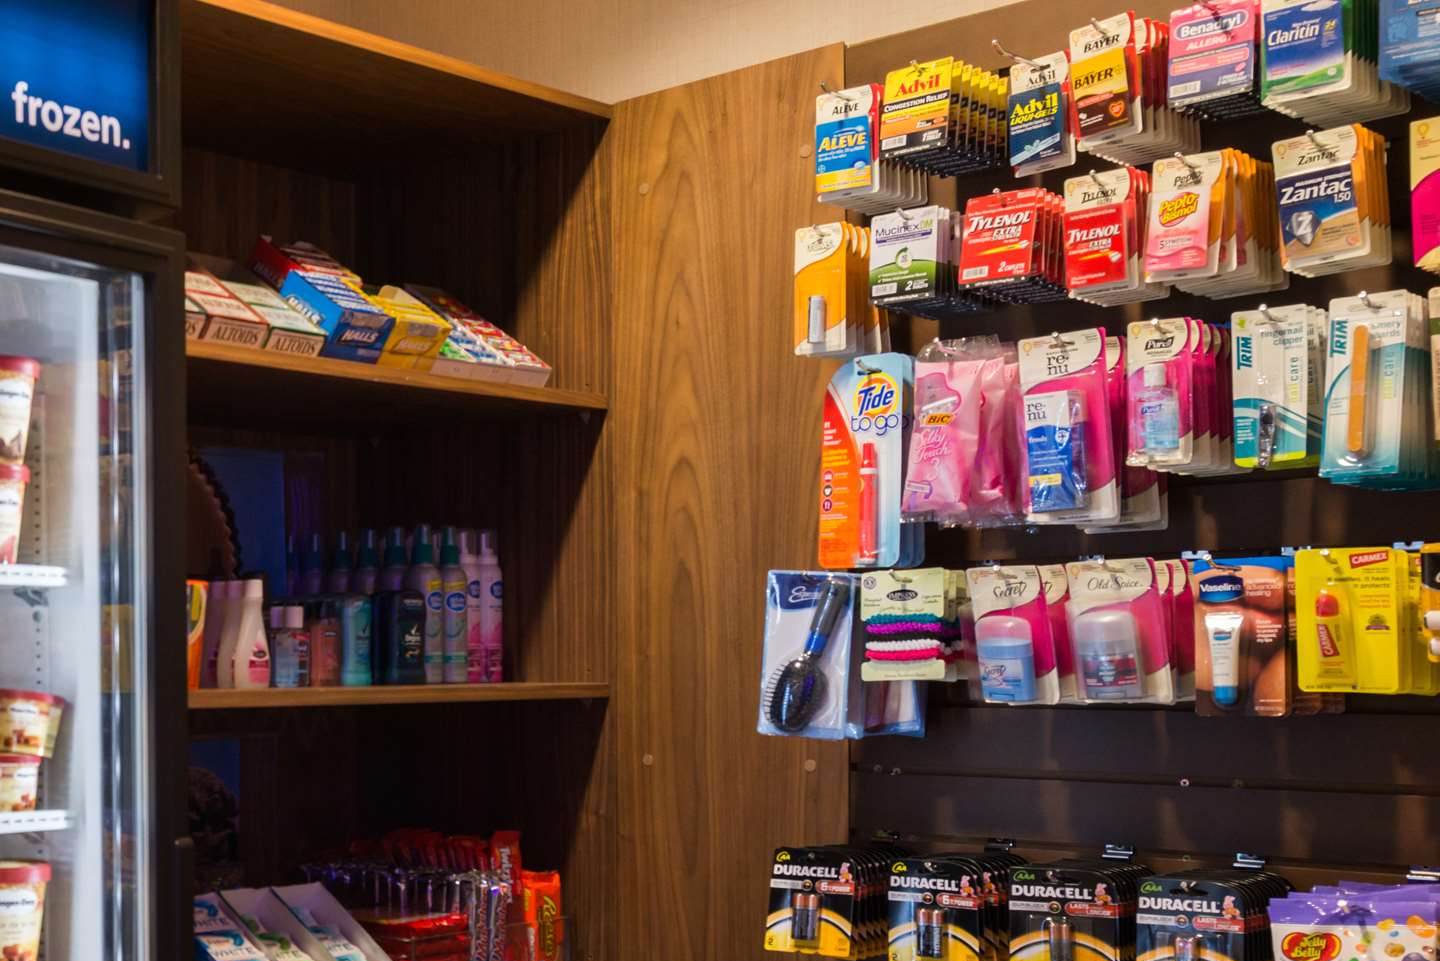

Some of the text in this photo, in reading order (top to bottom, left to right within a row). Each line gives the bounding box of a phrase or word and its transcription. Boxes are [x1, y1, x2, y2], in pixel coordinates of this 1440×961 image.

[1180, 13, 1242, 38] Benadryl
[1268, 22, 1320, 47] Claritin
[1083, 34, 1120, 53] BAYER
[896, 73, 941, 97] Advil
[1074, 67, 1114, 91] BAYER
[1011, 92, 1059, 118] Advil
[11, 80, 131, 150] frozen.
[818, 131, 867, 152] ALEVE
[1297, 149, 1340, 167] Zantac
[1081, 187, 1116, 204] TYLENOL
[1279, 179, 1352, 205] Zantac
[1333, 192, 1351, 204] 150
[875, 223, 919, 238] Mucinex
[968, 210, 1031, 233] TYLENOL
[1067, 223, 1121, 246] TYLENOL
[213, 325, 258, 345] ALTOIDS
[341, 329, 378, 344] HALLS
[1330, 319, 1348, 358] TRIM
[272, 337, 316, 355] ALTOIDS
[1237, 335, 1252, 370] TRIM
[858, 386, 894, 416] Tide
[851, 413, 899, 436] to go
[1351, 552, 1387, 566] CARMEX
[993, 580, 1027, 598] Secret
[1087, 577, 1139, 591] Old Spice
[1200, 582, 1242, 594] Vaseline
[773, 864, 838, 879] DURACELL
[890, 875, 959, 892] DURACELL
[1011, 884, 1092, 900] DURACELL
[1139, 896, 1220, 913] DURACELL
[1300, 936, 1327, 949] Jelly
[1292, 946, 1323, 961] Belly
